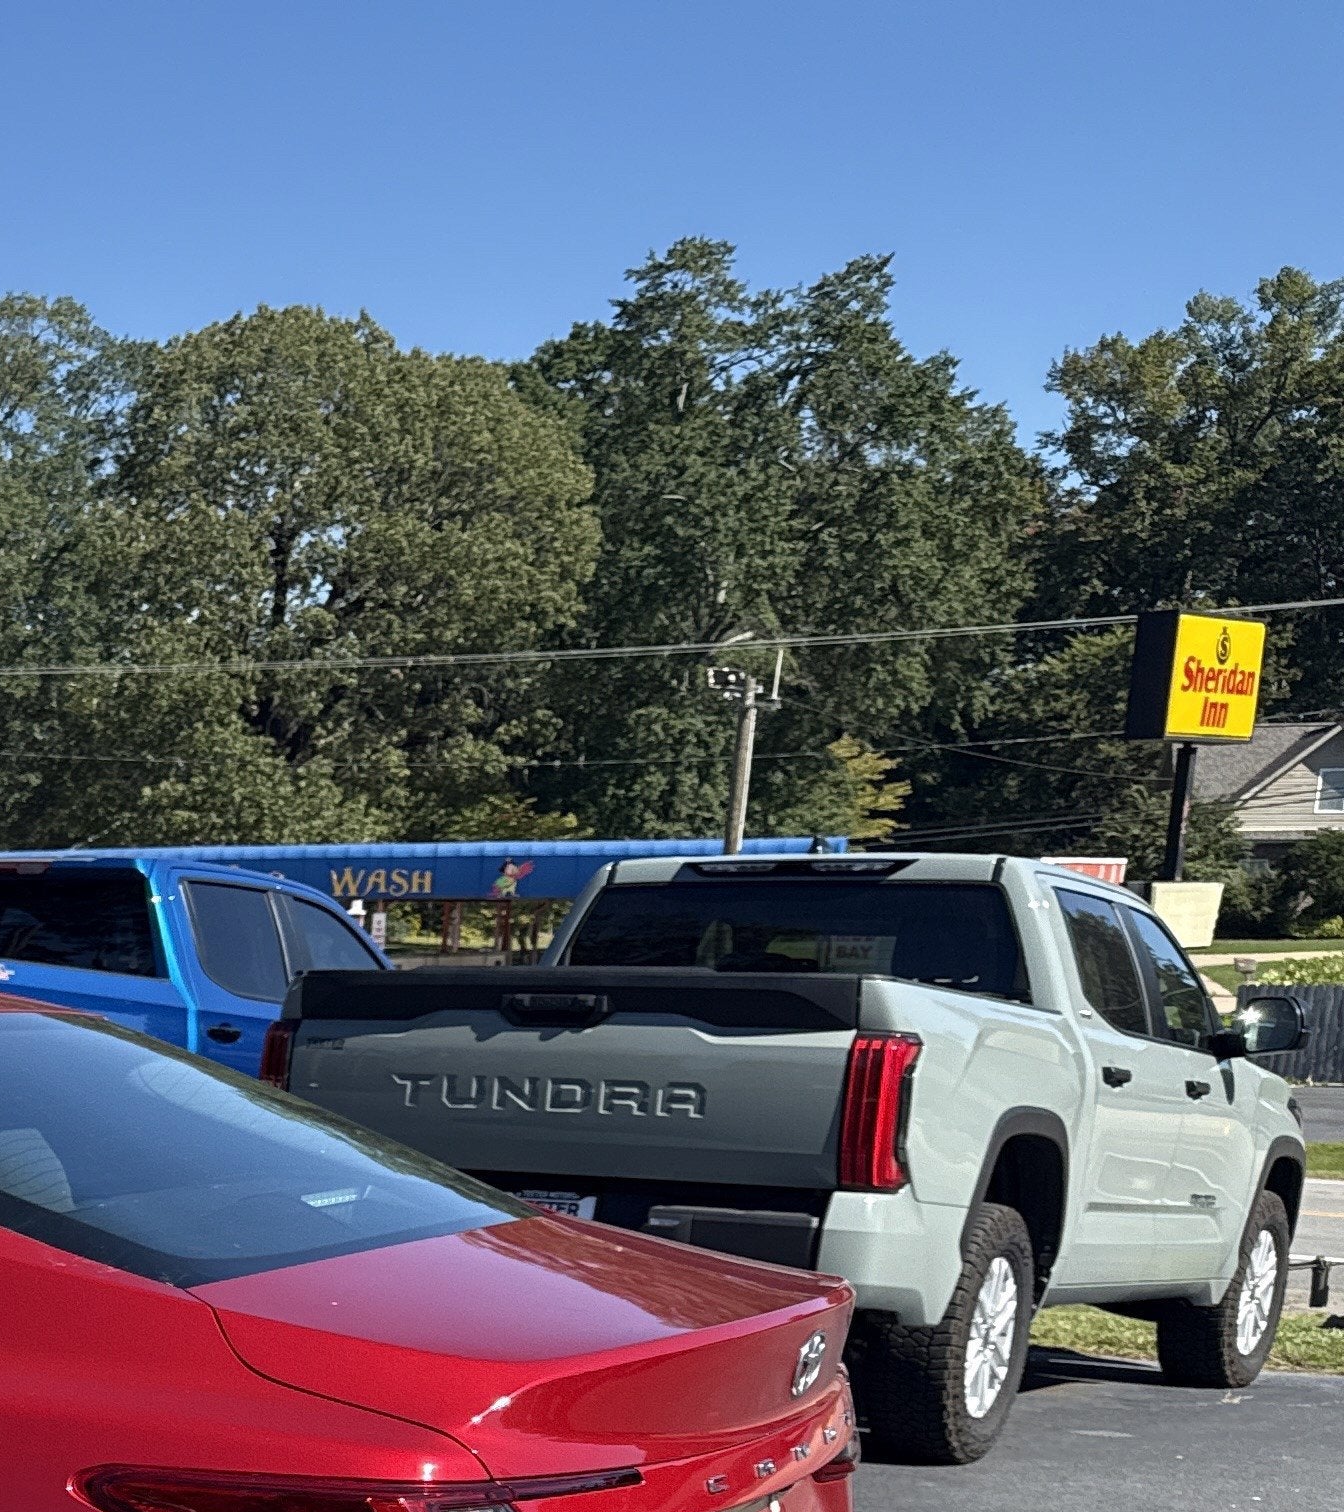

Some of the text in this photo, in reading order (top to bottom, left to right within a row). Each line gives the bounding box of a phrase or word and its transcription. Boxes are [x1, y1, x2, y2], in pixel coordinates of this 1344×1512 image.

[1180, 655, 1256, 697] Sheridan
[1199, 696, 1230, 729] Inn
[330, 865, 433, 898] WASH
[390, 1072, 709, 1120] TUNDRA
